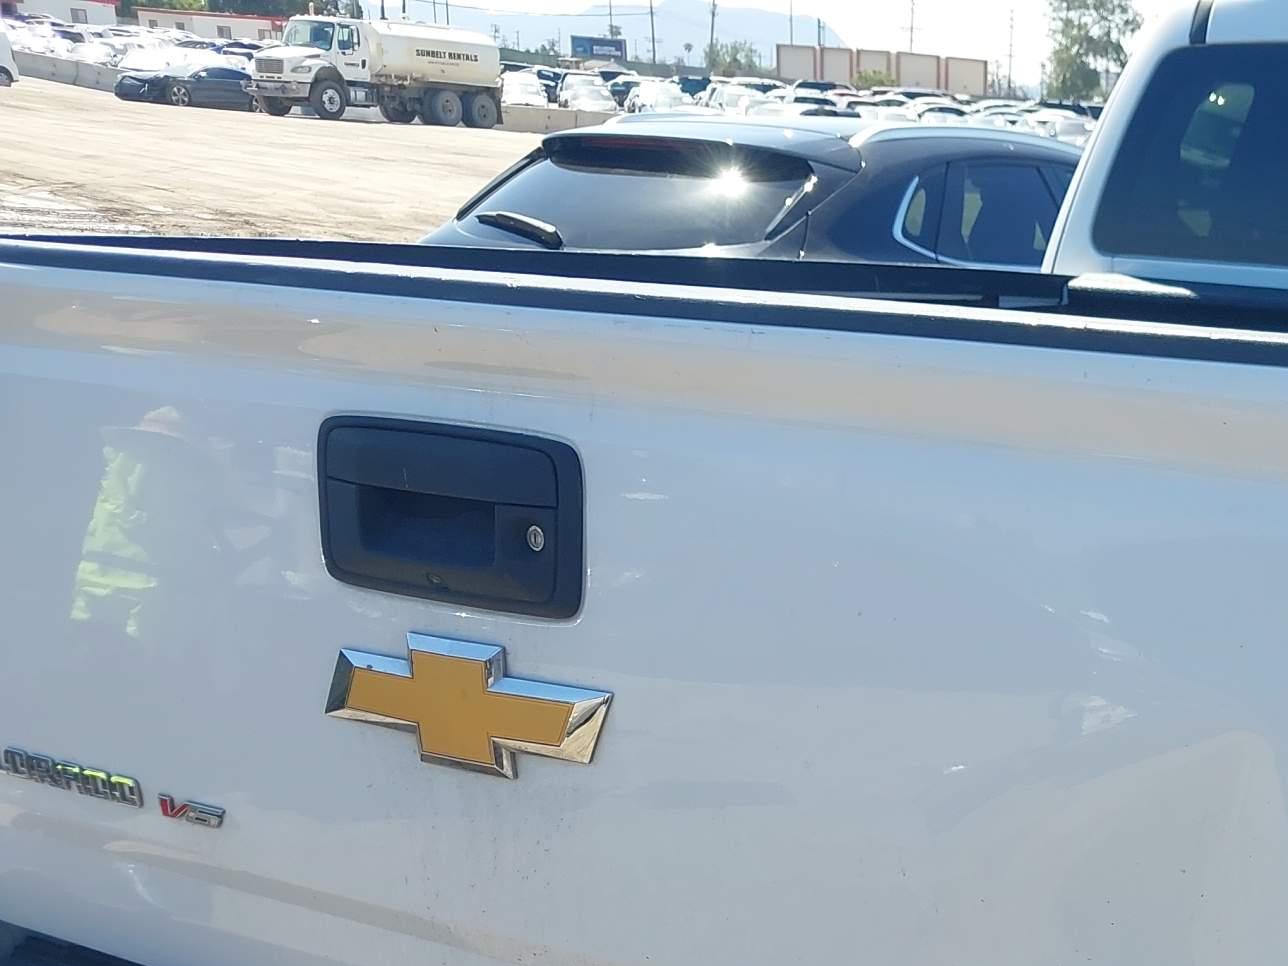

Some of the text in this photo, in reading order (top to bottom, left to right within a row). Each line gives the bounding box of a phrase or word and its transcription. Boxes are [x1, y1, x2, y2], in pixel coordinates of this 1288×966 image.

[415, 49, 479, 62] SUNBELT RENTALS
[158, 793, 226, 828] V6
